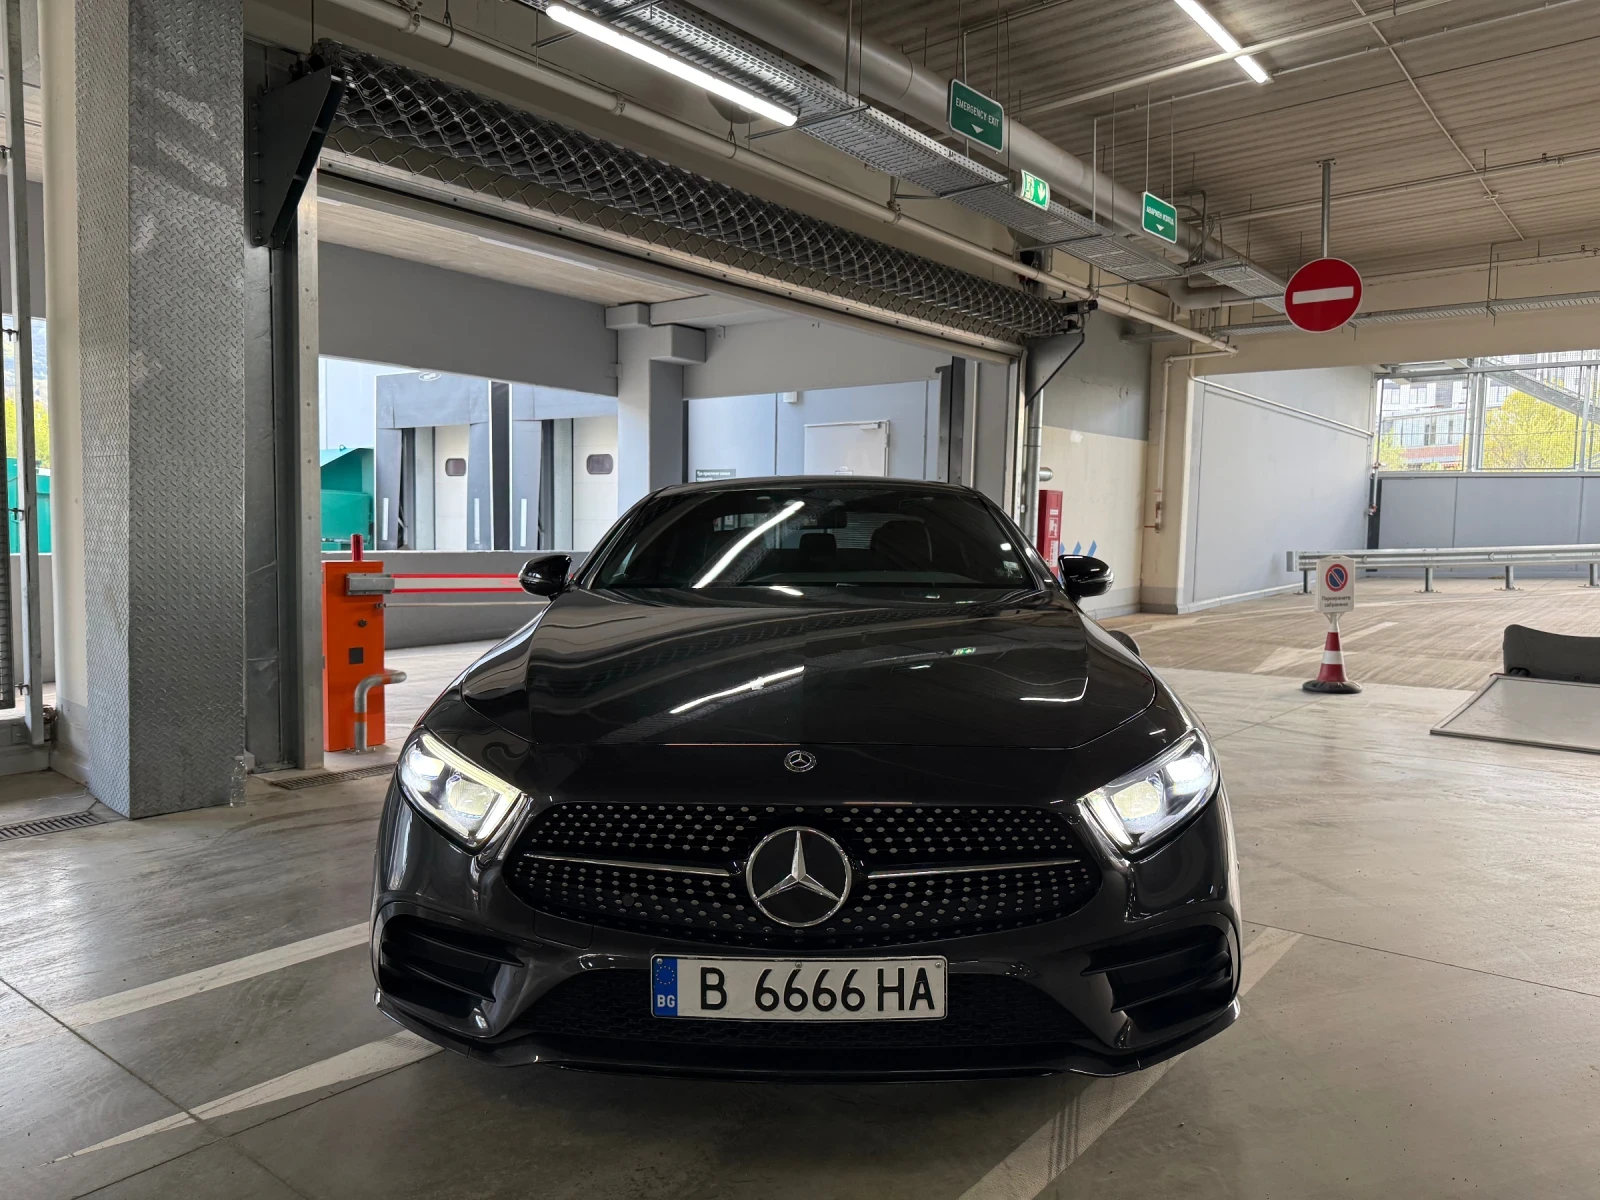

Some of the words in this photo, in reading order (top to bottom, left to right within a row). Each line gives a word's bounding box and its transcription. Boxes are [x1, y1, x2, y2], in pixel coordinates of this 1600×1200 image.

[955, 97, 987, 120] EMERGENCY
[988, 115, 1000, 127] EXIT
[656, 994, 676, 1008] BG
[700, 966, 728, 1011] B
